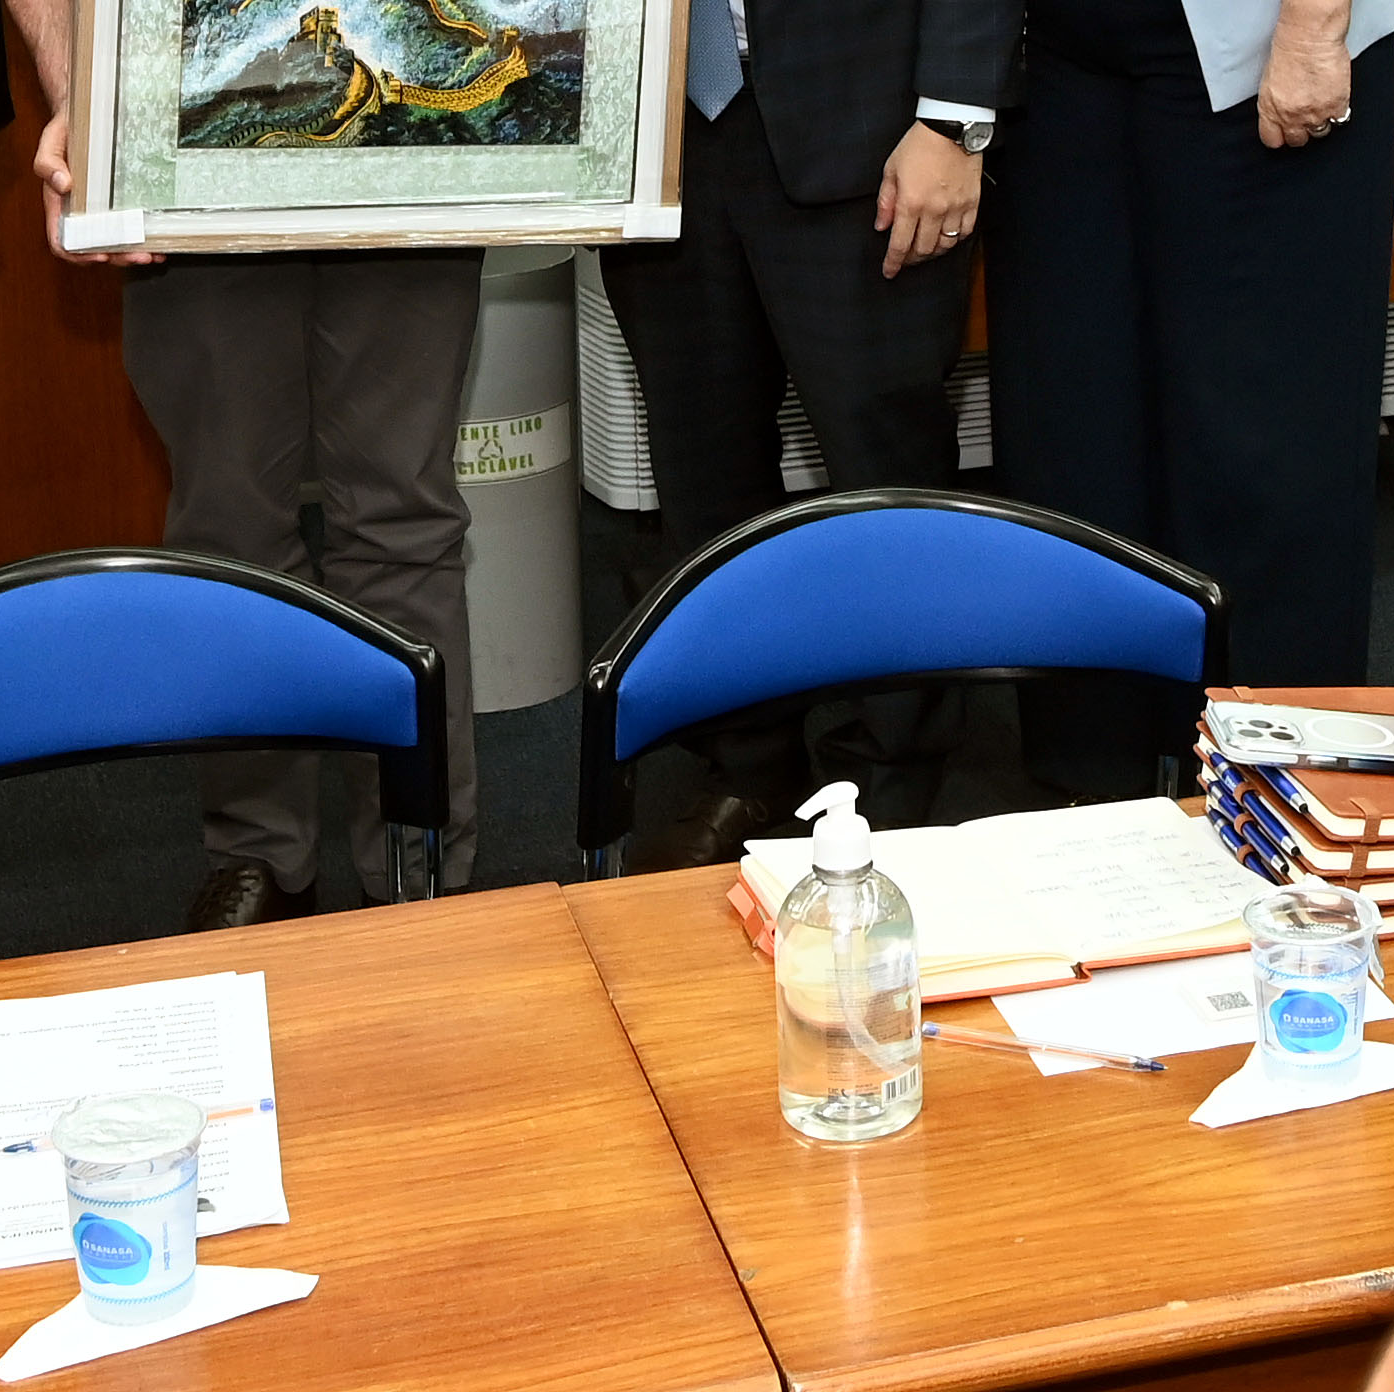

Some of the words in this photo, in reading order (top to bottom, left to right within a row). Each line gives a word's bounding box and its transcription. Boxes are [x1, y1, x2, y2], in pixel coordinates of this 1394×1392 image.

[510, 416, 542, 435] LIXO
[1292, 1015, 1334, 1025] SANASA
[90, 1243, 133, 1255] SANASA
